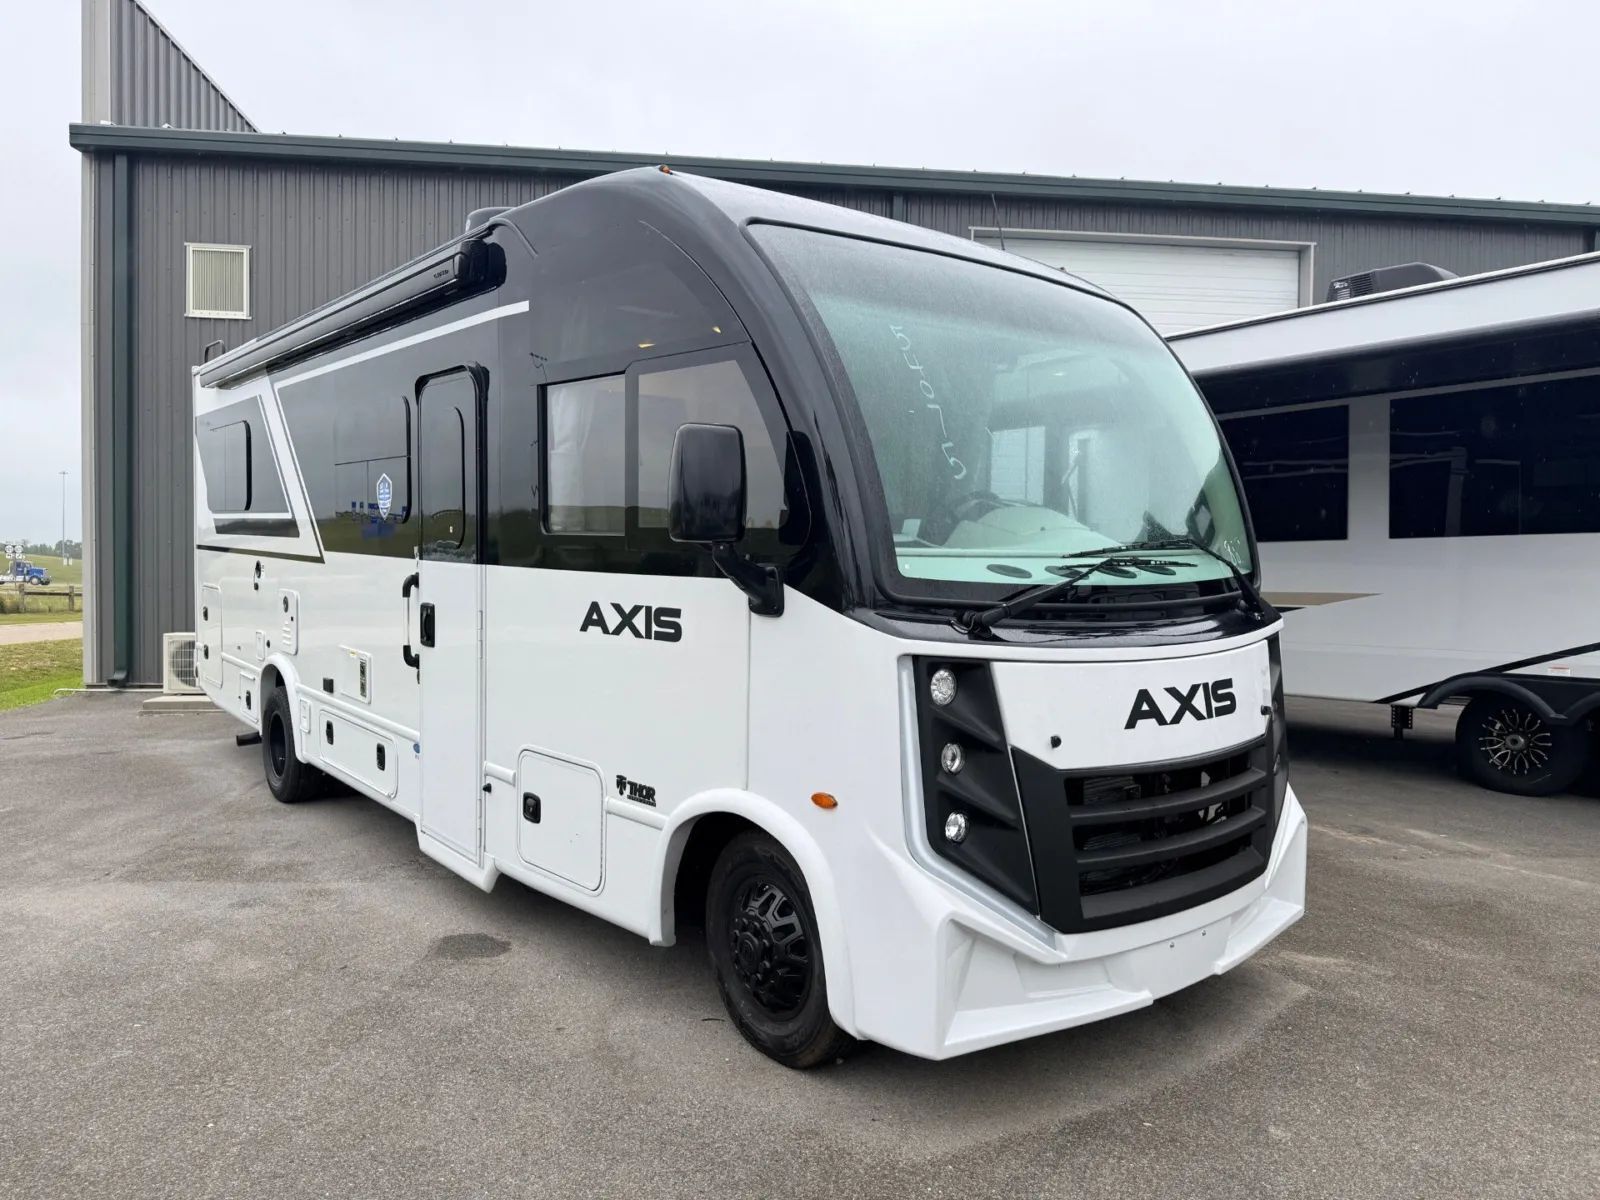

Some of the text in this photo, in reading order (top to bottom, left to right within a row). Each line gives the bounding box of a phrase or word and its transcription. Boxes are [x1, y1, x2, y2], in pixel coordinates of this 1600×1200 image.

[579, 600, 682, 643] AXIS
[1124, 678, 1237, 729] AXIS
[627, 780, 656, 802] THOR
